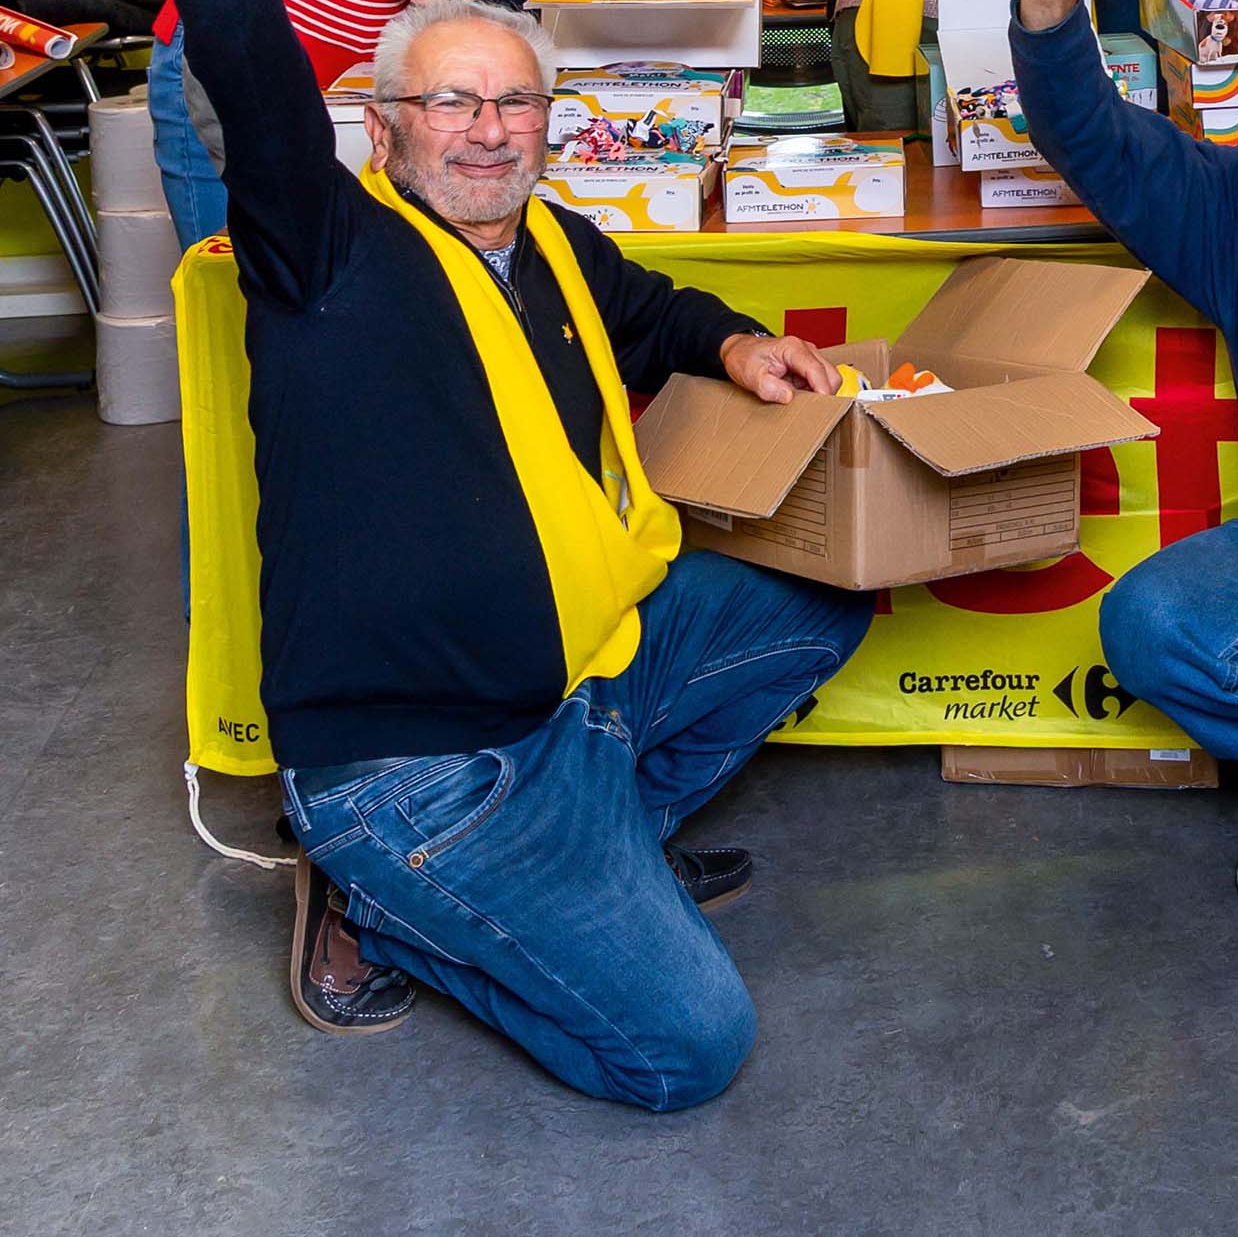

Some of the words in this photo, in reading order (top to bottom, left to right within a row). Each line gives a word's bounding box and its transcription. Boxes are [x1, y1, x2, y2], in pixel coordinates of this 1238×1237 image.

[899, 669, 1040, 694] Carrefour
[944, 695, 1041, 721] market
[218, 716, 260, 742] AVEC
